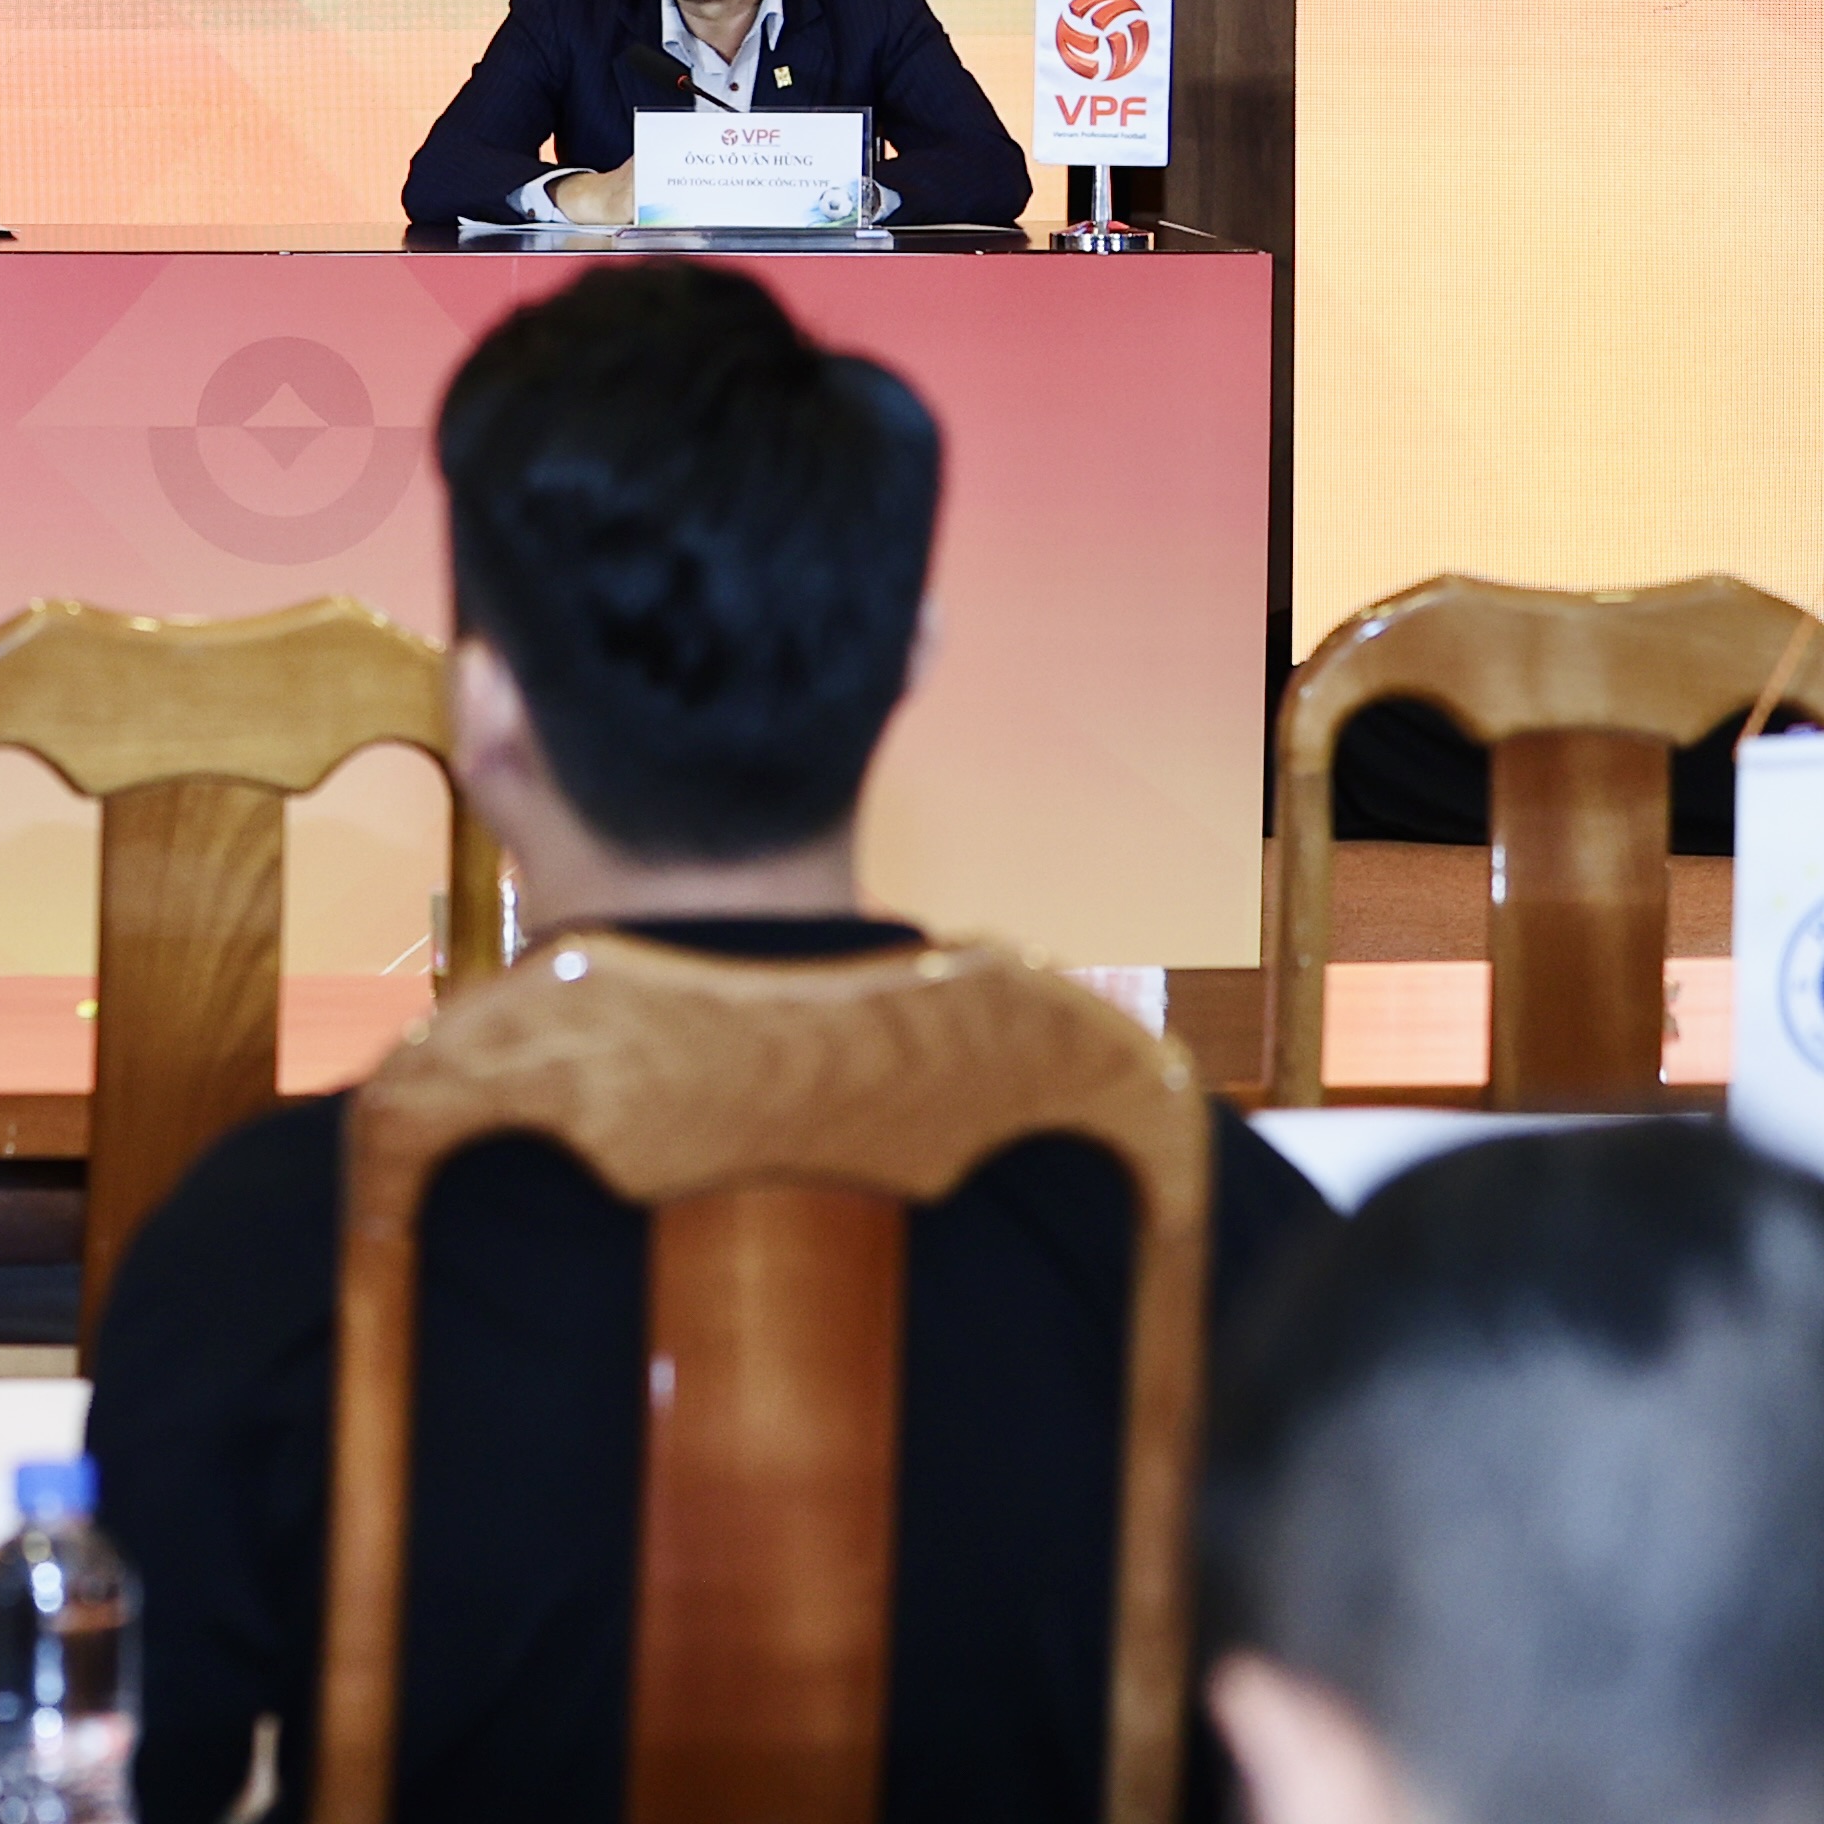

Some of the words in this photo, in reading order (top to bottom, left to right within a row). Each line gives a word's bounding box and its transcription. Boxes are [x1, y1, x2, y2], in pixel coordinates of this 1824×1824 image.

[1055, 94, 1147, 127] VPF
[741, 128, 781, 144] VPF
[685, 151, 715, 166] ÔNG
[742, 152, 769, 166] VĂN
